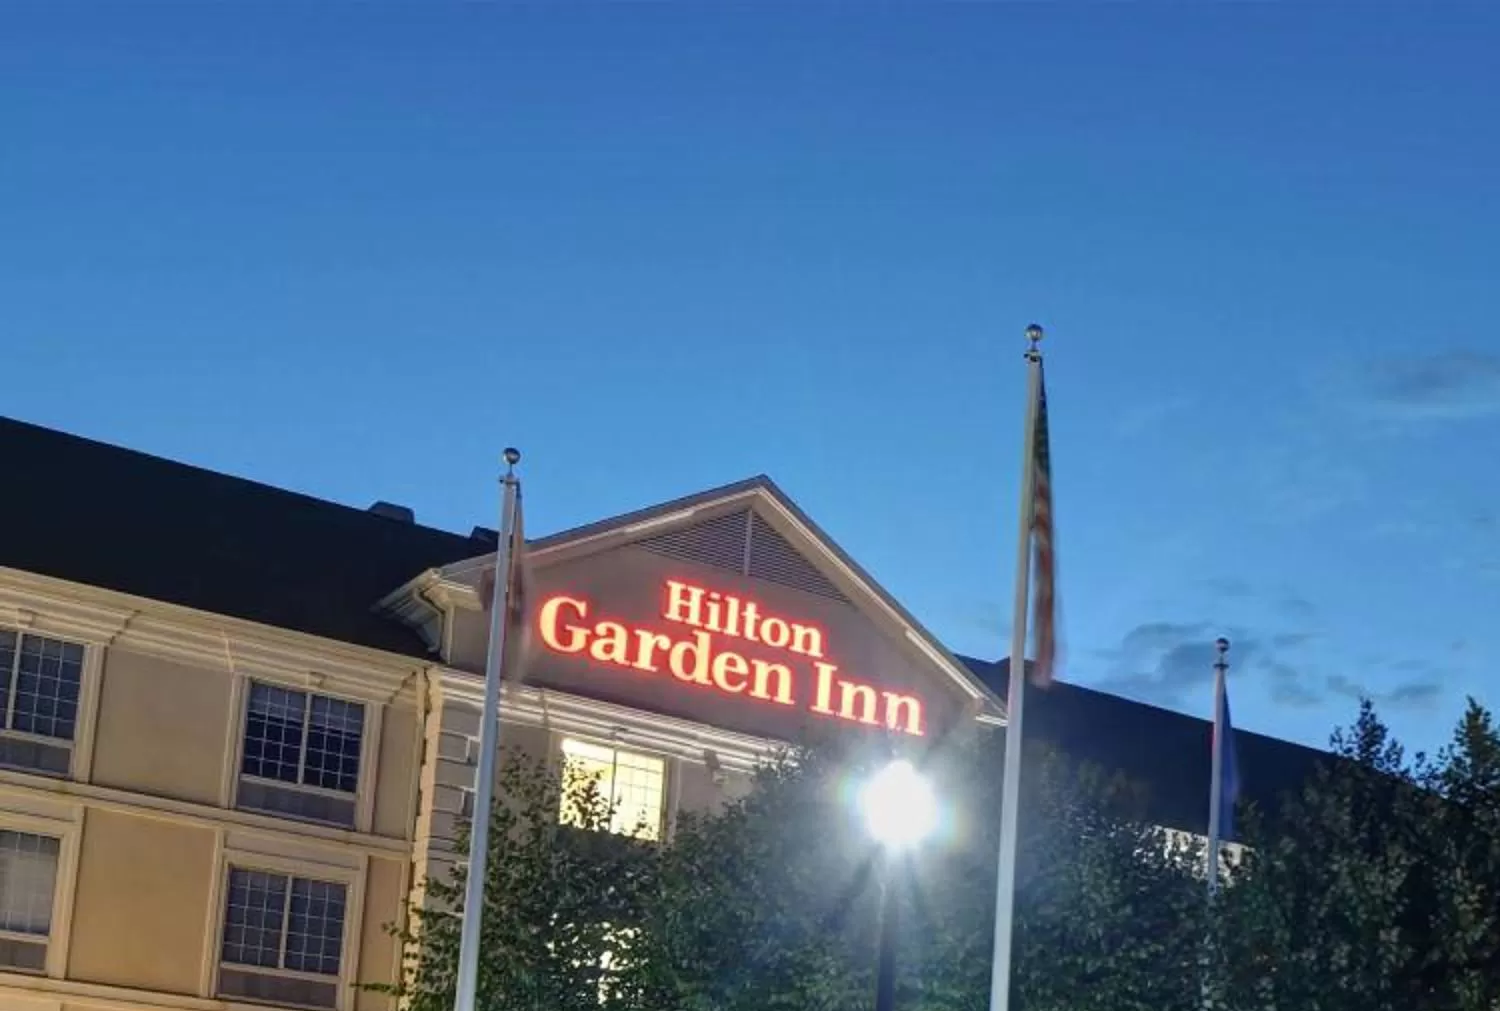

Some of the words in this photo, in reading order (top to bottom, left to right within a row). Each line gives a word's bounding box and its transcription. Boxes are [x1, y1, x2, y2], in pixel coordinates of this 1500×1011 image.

[538, 595, 796, 707] Garden
[809, 659, 925, 737] Inn
[662, 579, 824, 659] Hilton
